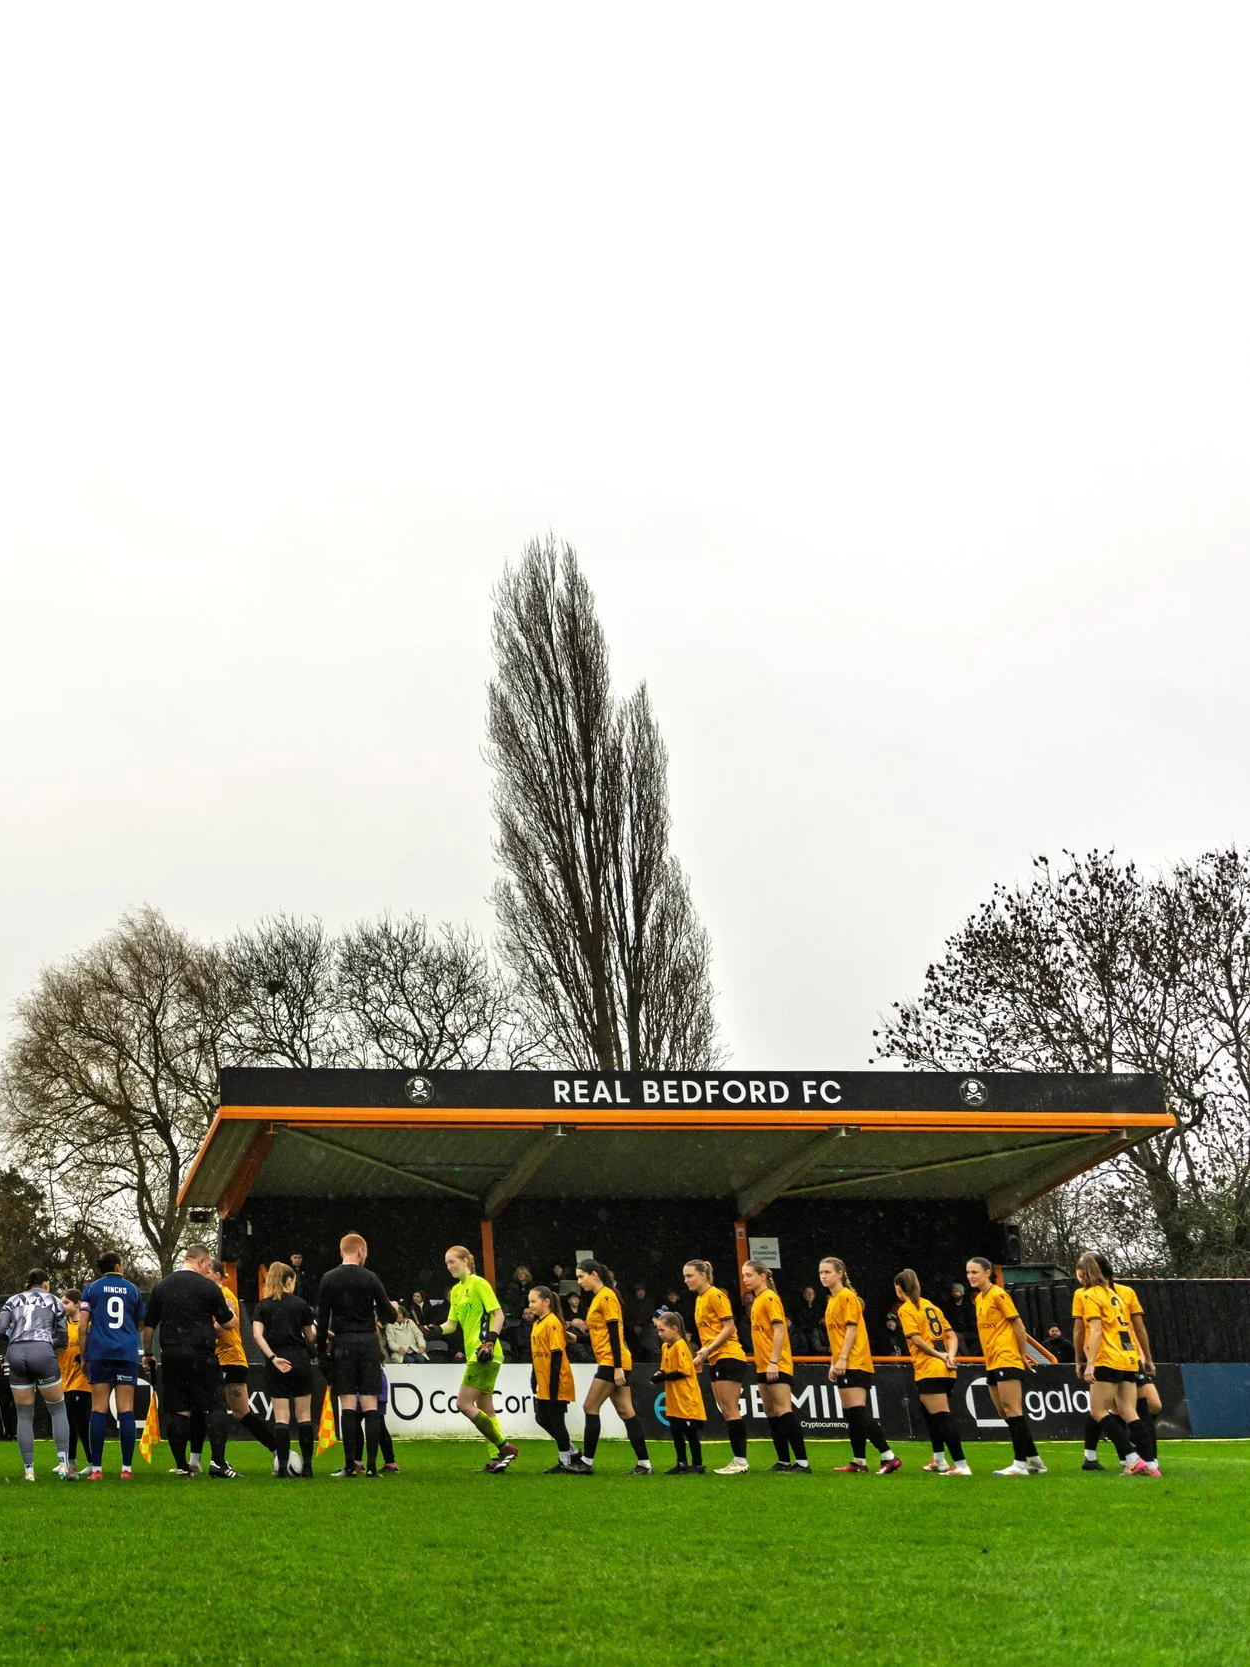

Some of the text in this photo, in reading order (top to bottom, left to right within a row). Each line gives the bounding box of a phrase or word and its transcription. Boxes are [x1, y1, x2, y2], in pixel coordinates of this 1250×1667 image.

[553, 1080, 842, 1104] REAL BEDFORD FC
[103, 1286, 128, 1295] HINCKS
[106, 1296, 125, 1329] 9
[924, 1306, 943, 1338] 8
[716, 1384, 881, 1420] EMII
[1024, 1383, 1091, 1421] gala
[800, 1421, 849, 1429] Cryptocurrency
